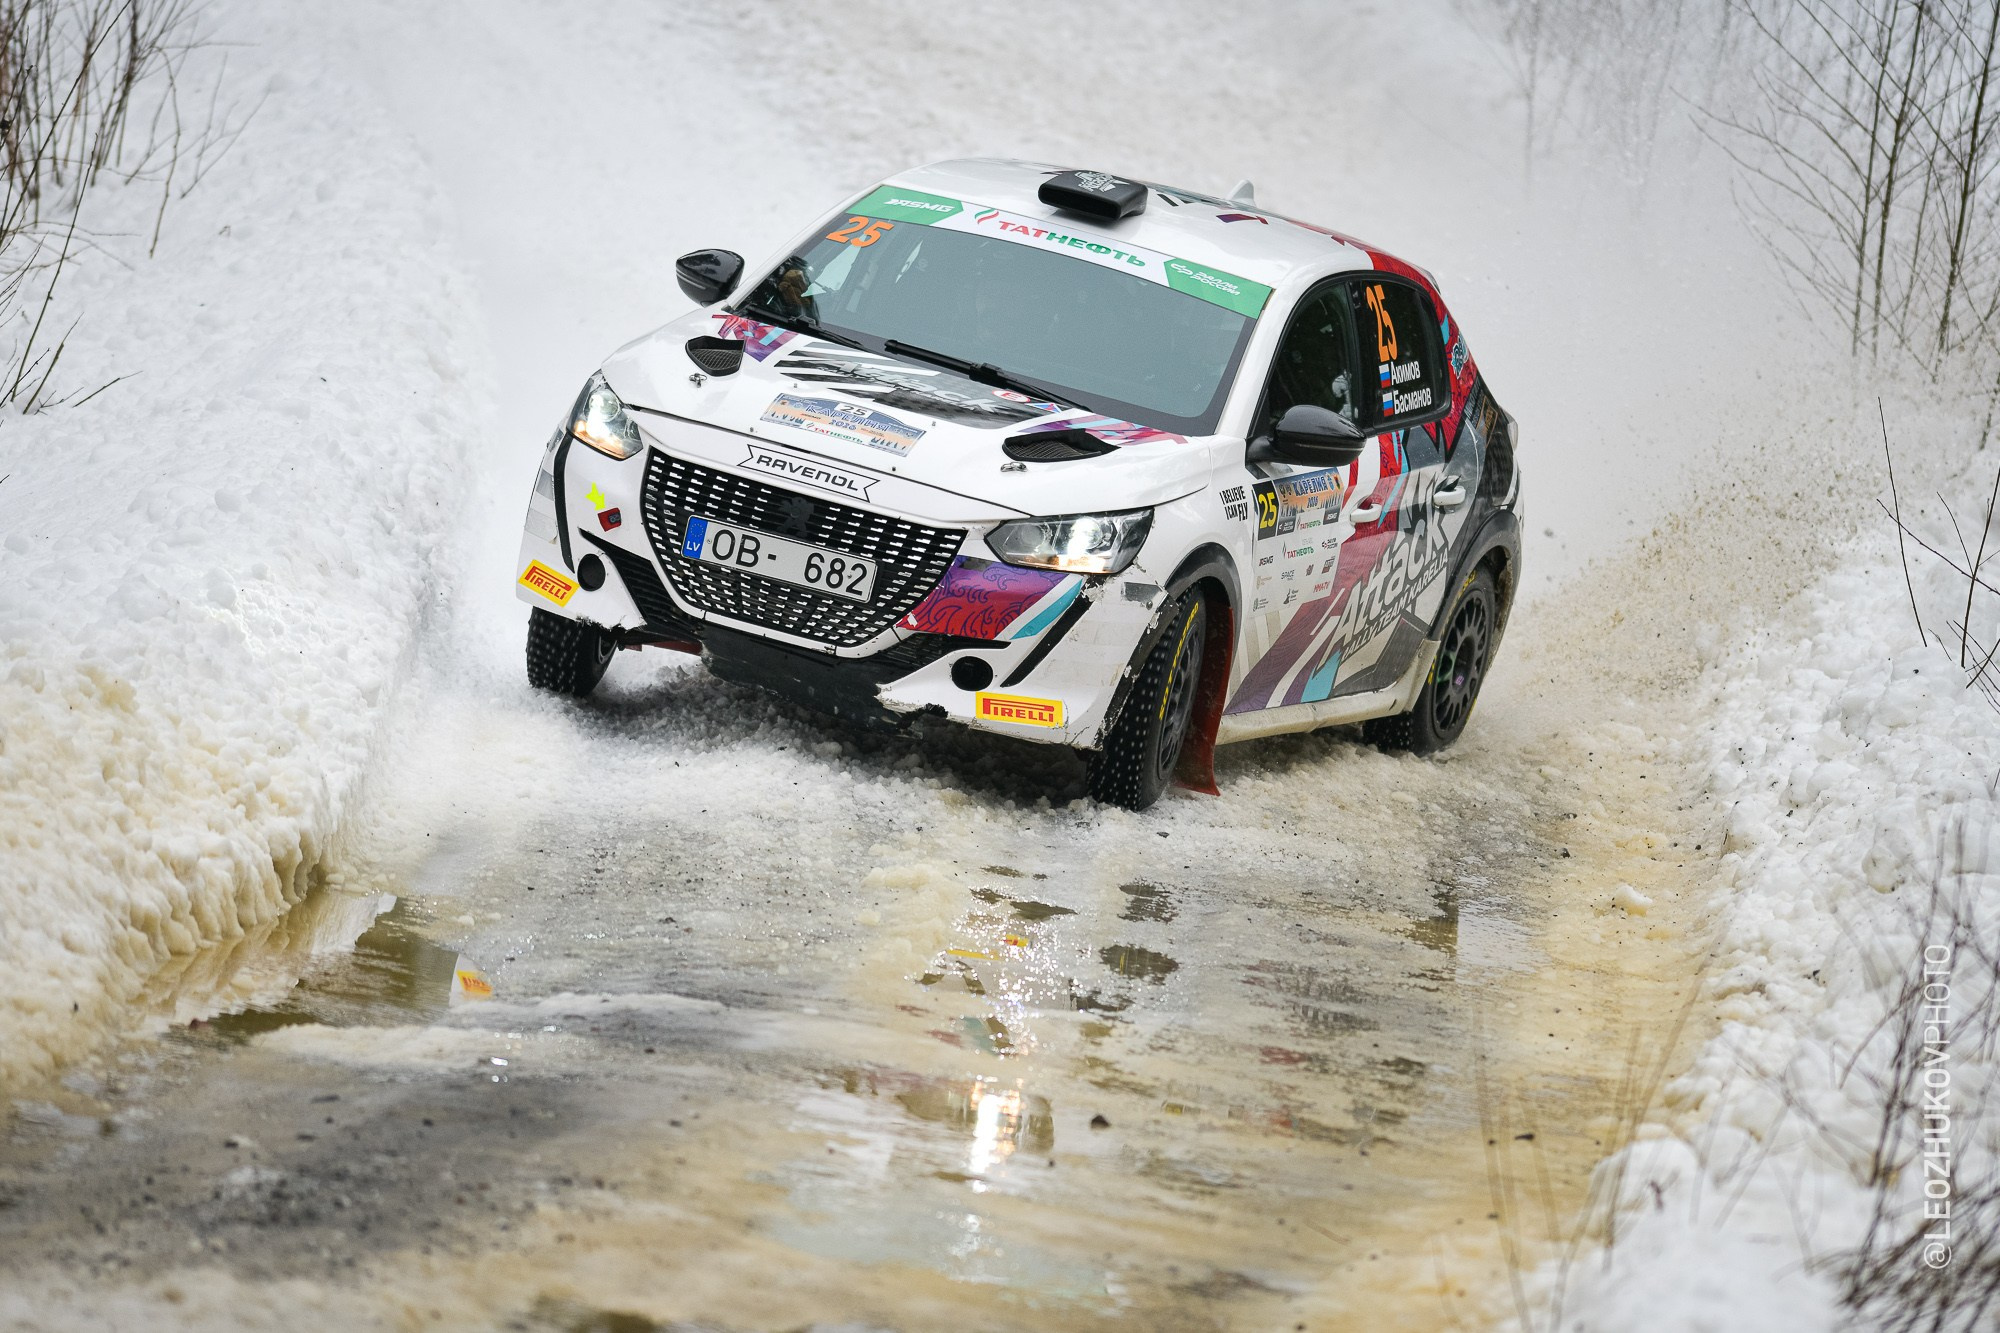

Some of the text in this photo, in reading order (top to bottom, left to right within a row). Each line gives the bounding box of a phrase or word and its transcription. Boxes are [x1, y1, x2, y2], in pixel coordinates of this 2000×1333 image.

[826, 215, 894, 248] 25
[998, 220, 1146, 268] ТАТНЕФТЬ
[1366, 284, 1398, 363] 25
[1390, 360, 1421, 386] Акимов
[840, 405, 867, 416] 25
[1393, 387, 1432, 415] Басманов
[806, 404, 891, 432] КАРЕЛИЯ
[814, 427, 864, 444] ТАТНЕФТЬ
[756, 454, 860, 492] RAVENOL
[1292, 475, 1329, 497] КАРЕЛИЯ
[1222, 485, 1246, 503] BELIEVE
[1228, 504, 1238, 519] CAN
[1237, 502, 1248, 522] FLY
[1258, 492, 1277, 529] 25
[686, 540, 700, 552] LV
[1286, 546, 1315, 559] ТАТНЕФТЬ
[524, 565, 572, 601] PIRELLI
[803, 552, 868, 596] 682
[1377, 591, 1408, 633] TEAM
[1408, 547, 1448, 603] KARELIA
[982, 698, 1055, 722] PIRELLI
